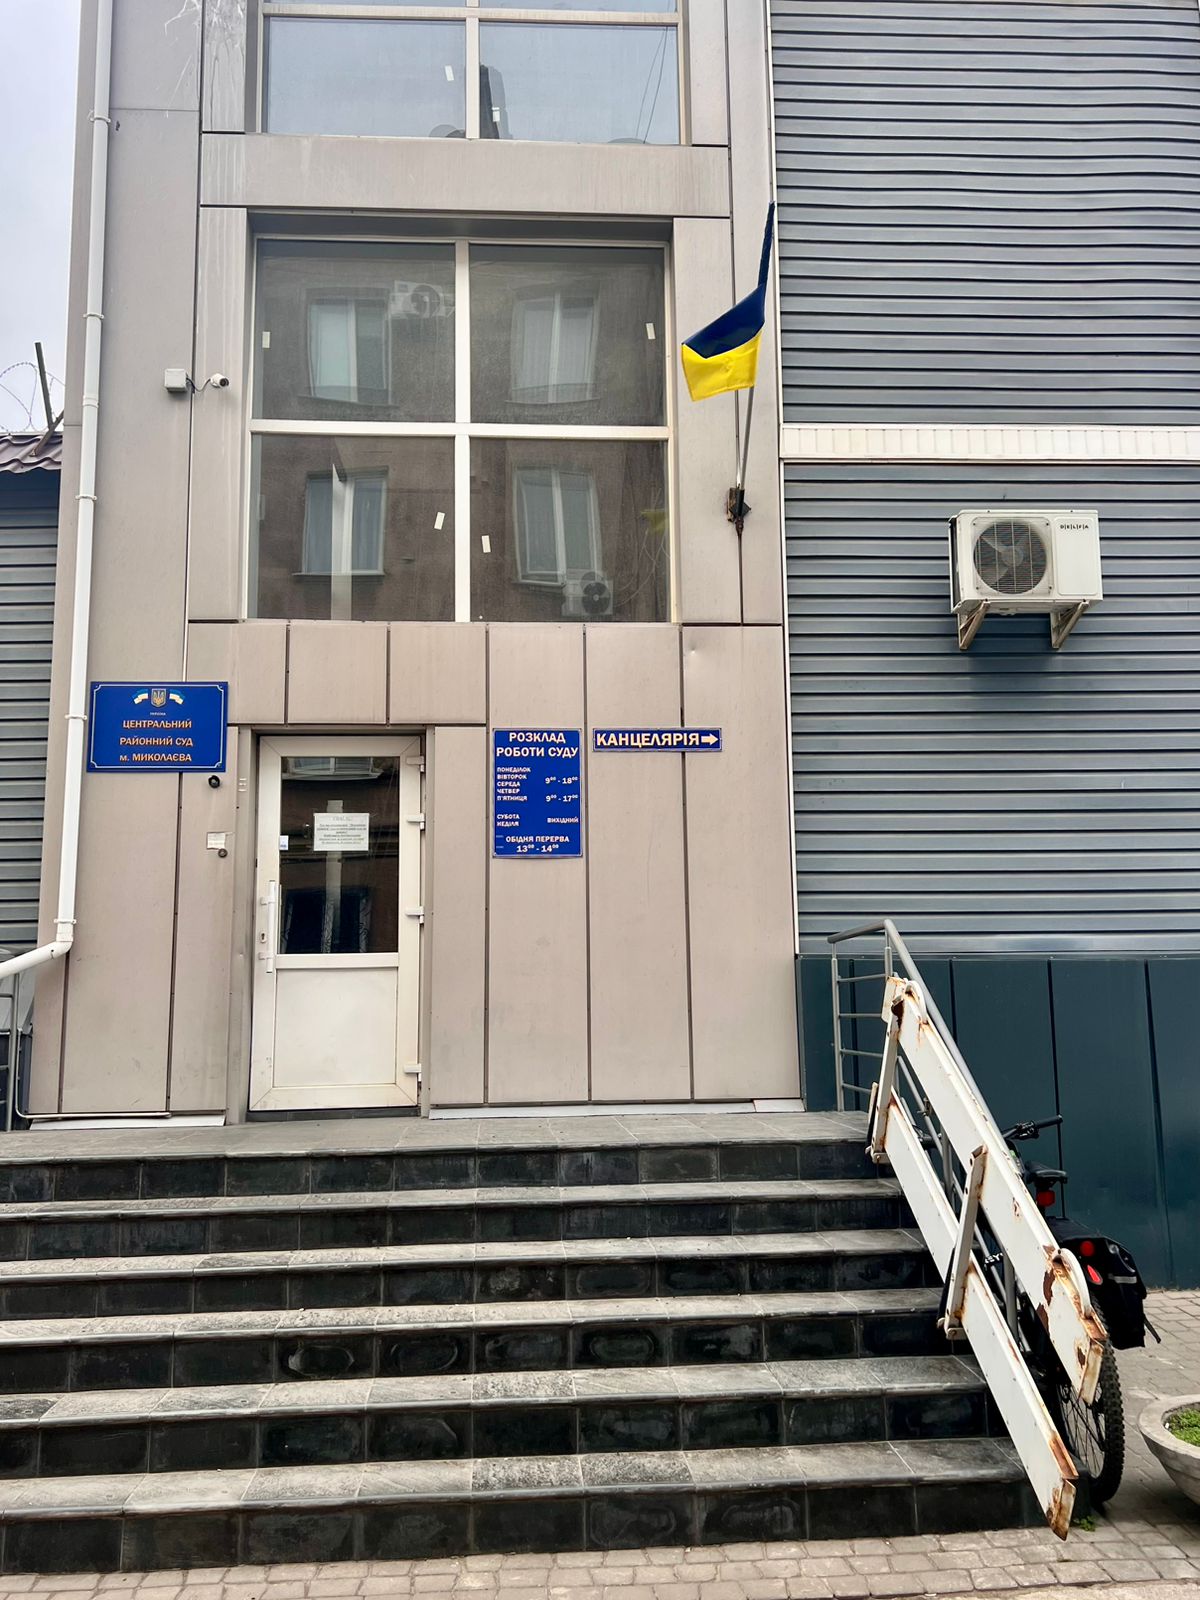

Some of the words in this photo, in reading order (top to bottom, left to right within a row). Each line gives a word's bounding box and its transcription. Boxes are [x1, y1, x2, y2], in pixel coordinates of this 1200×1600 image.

[122, 719, 192, 729] ЦЕНТРАЛЬНИЙ
[119, 736, 173, 746] РАЙОННИЙ
[175, 737, 193, 747] СУД
[509, 732, 566, 743] РОЗКЛАД
[596, 733, 700, 748] КАНЦЕЛЯРІЯ
[132, 753, 192, 762] МИКОЛАЄВА
[496, 747, 545, 757] РОБОТИ
[547, 747, 579, 758] СУДУ
[547, 816, 579, 824] ВИХІДНИЙ
[535, 835, 570, 843] ПЕРЕРВА
